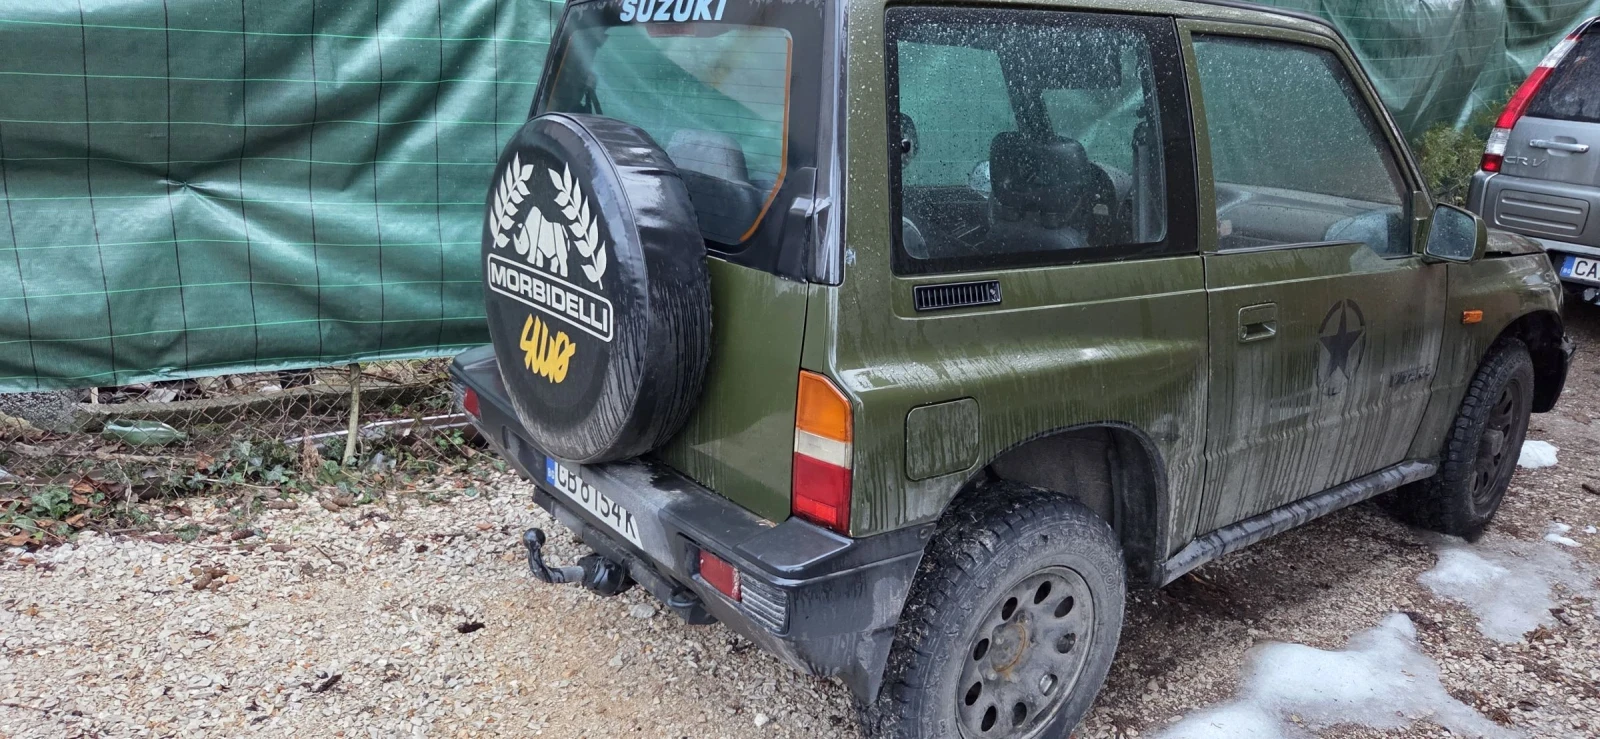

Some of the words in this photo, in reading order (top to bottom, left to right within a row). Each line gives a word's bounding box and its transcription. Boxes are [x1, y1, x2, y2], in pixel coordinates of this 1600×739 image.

[619, 0, 726, 22] SUZUKI
[1574, 260, 1598, 278] CA
[490, 262, 608, 333] MORBIDELLI
